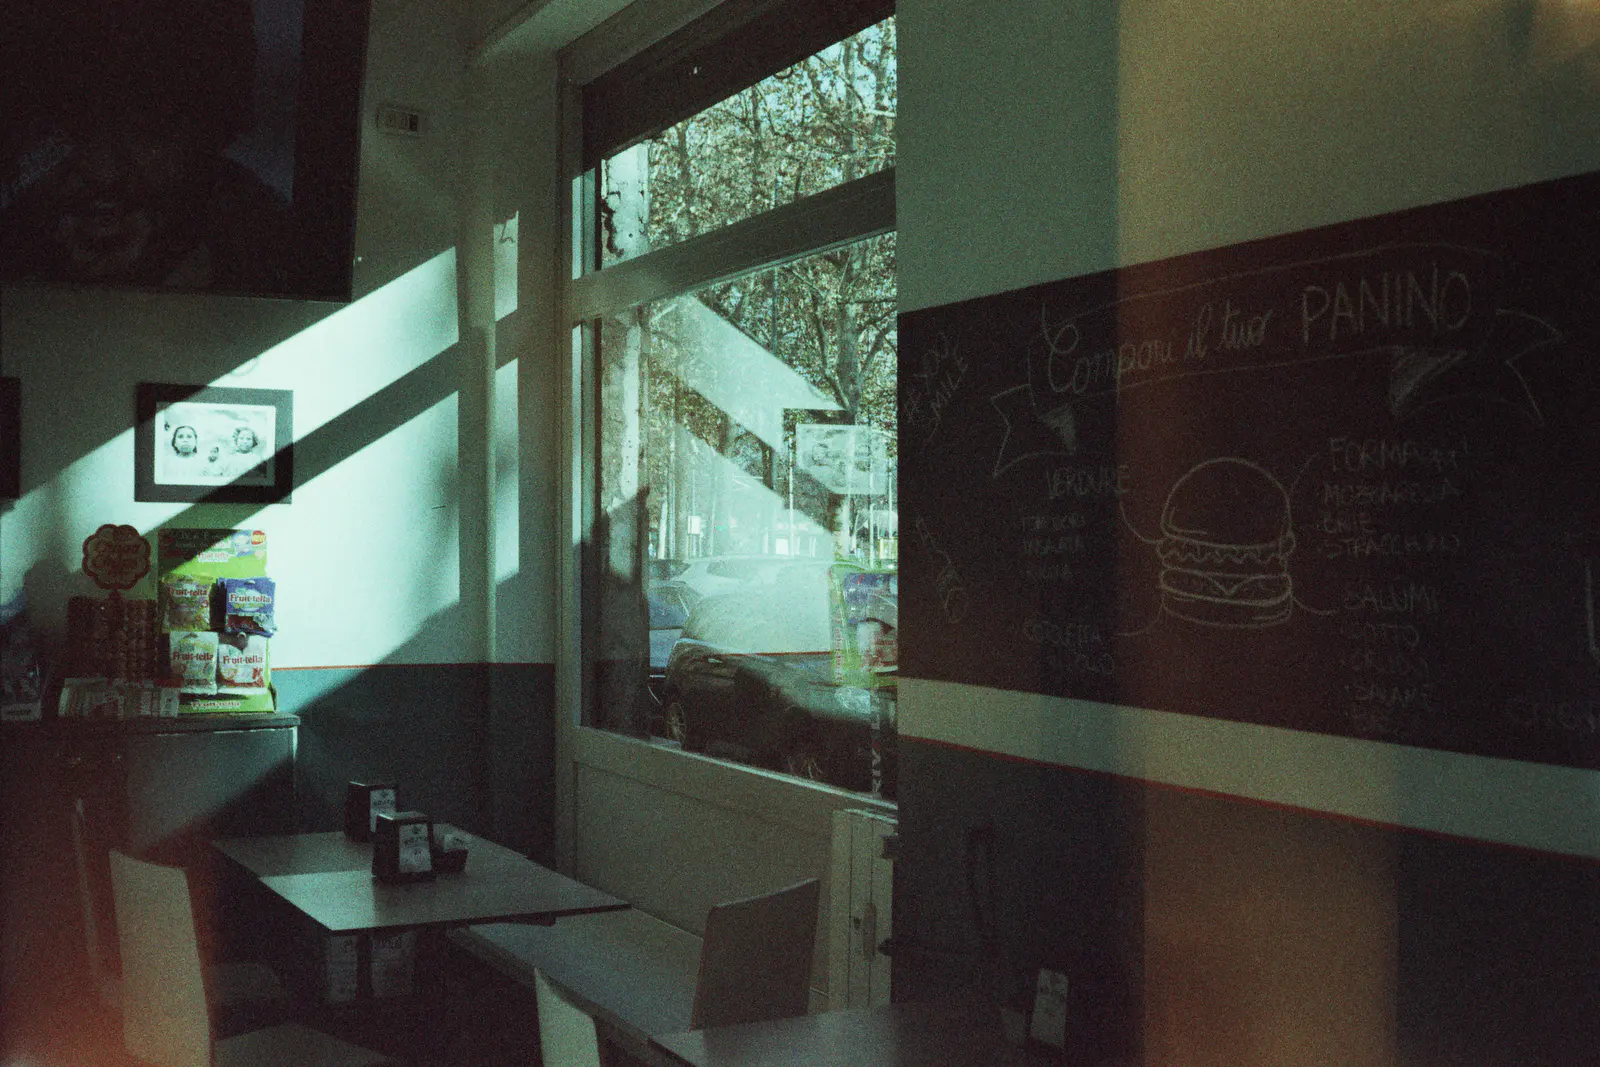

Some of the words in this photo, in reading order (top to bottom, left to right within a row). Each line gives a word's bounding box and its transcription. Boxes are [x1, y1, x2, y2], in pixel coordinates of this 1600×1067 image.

[1042, 303, 1175, 402] Componi
[1184, 302, 1213, 359] il
[1219, 298, 1275, 350] tuo
[1301, 261, 1474, 344] PANINO
